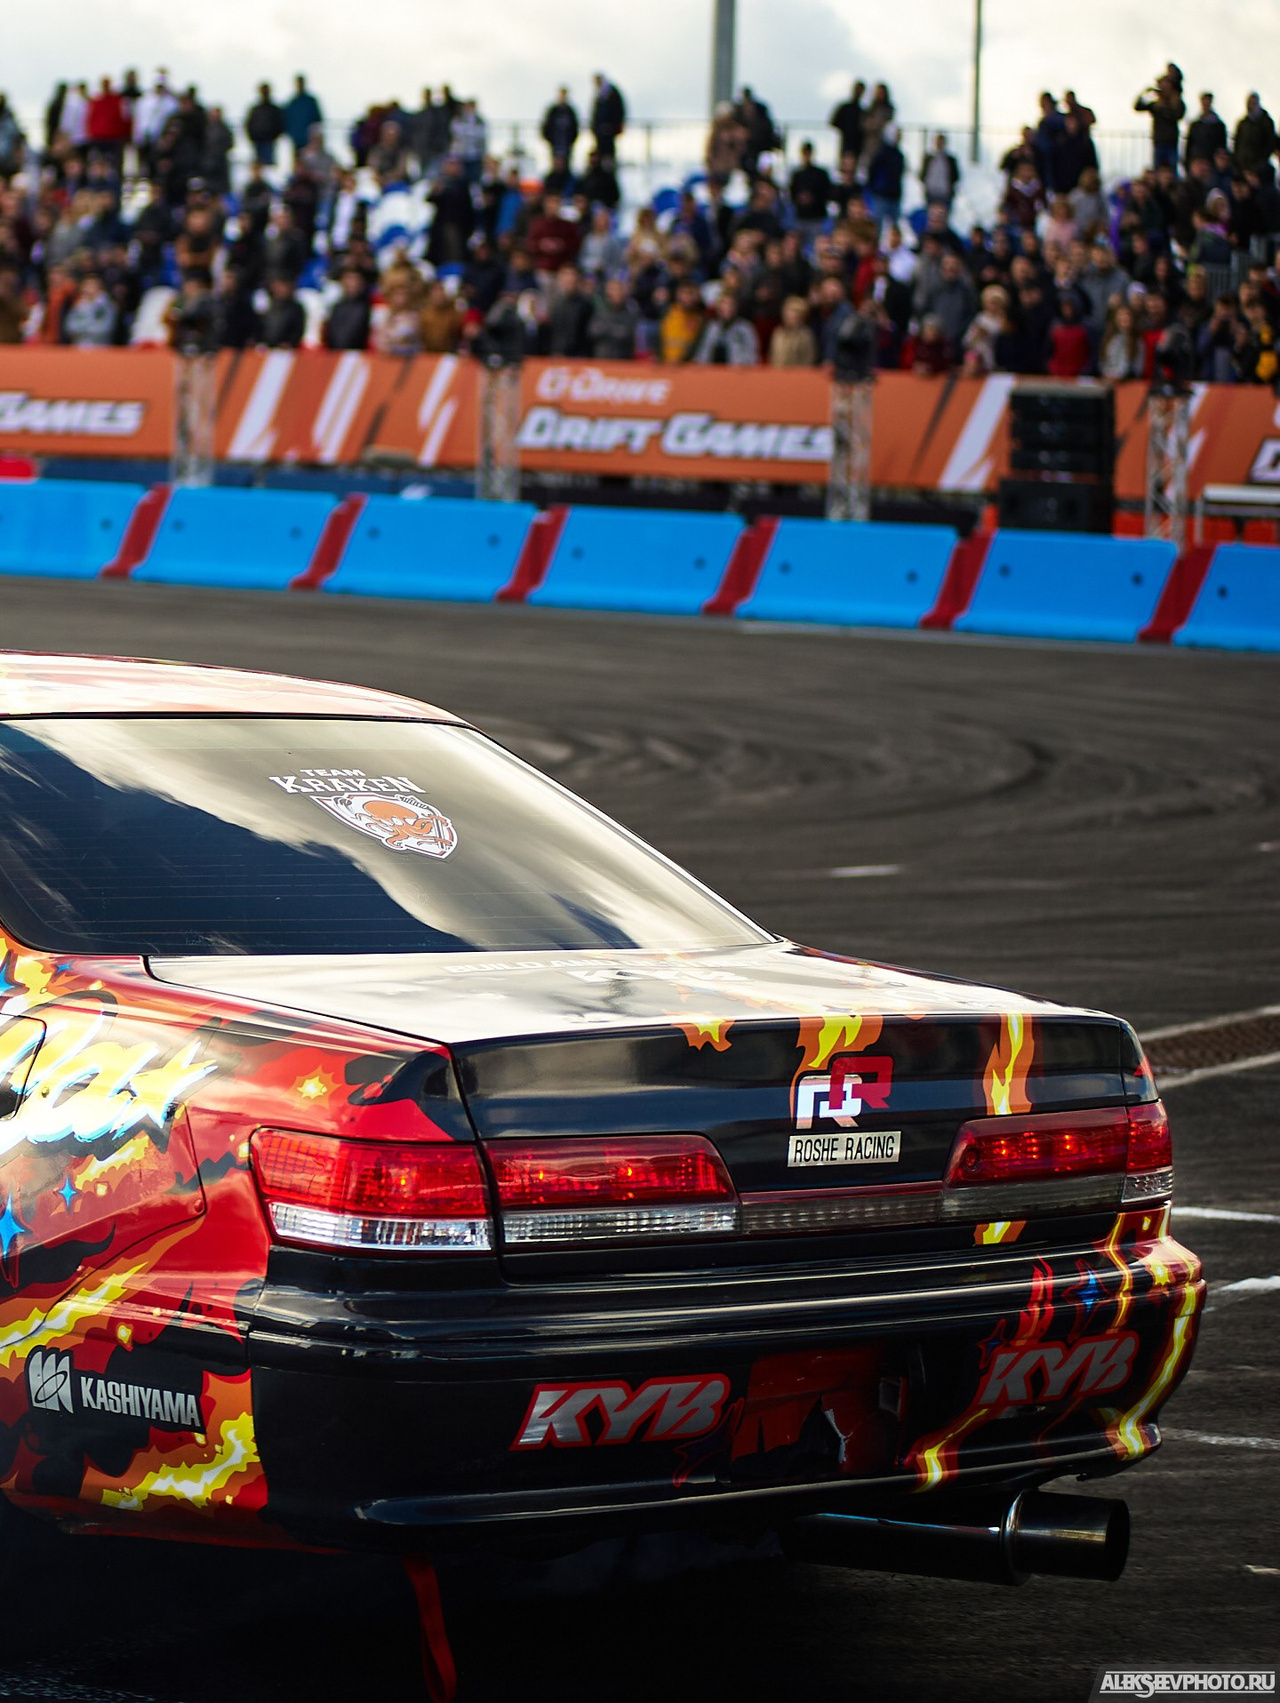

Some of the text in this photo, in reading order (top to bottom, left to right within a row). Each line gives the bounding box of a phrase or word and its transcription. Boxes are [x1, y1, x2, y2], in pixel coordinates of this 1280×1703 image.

[517, 405, 664, 453] DRIFT
[269, 775, 428, 794] KRAKEN
[300, 769, 366, 778] TEAM
[793, 1135, 895, 1163] ROSHE RACING
[975, 1333, 1137, 1407] KYB
[80, 1376, 202, 1428] KASHIYAMA
[516, 1377, 726, 1447] KYB
